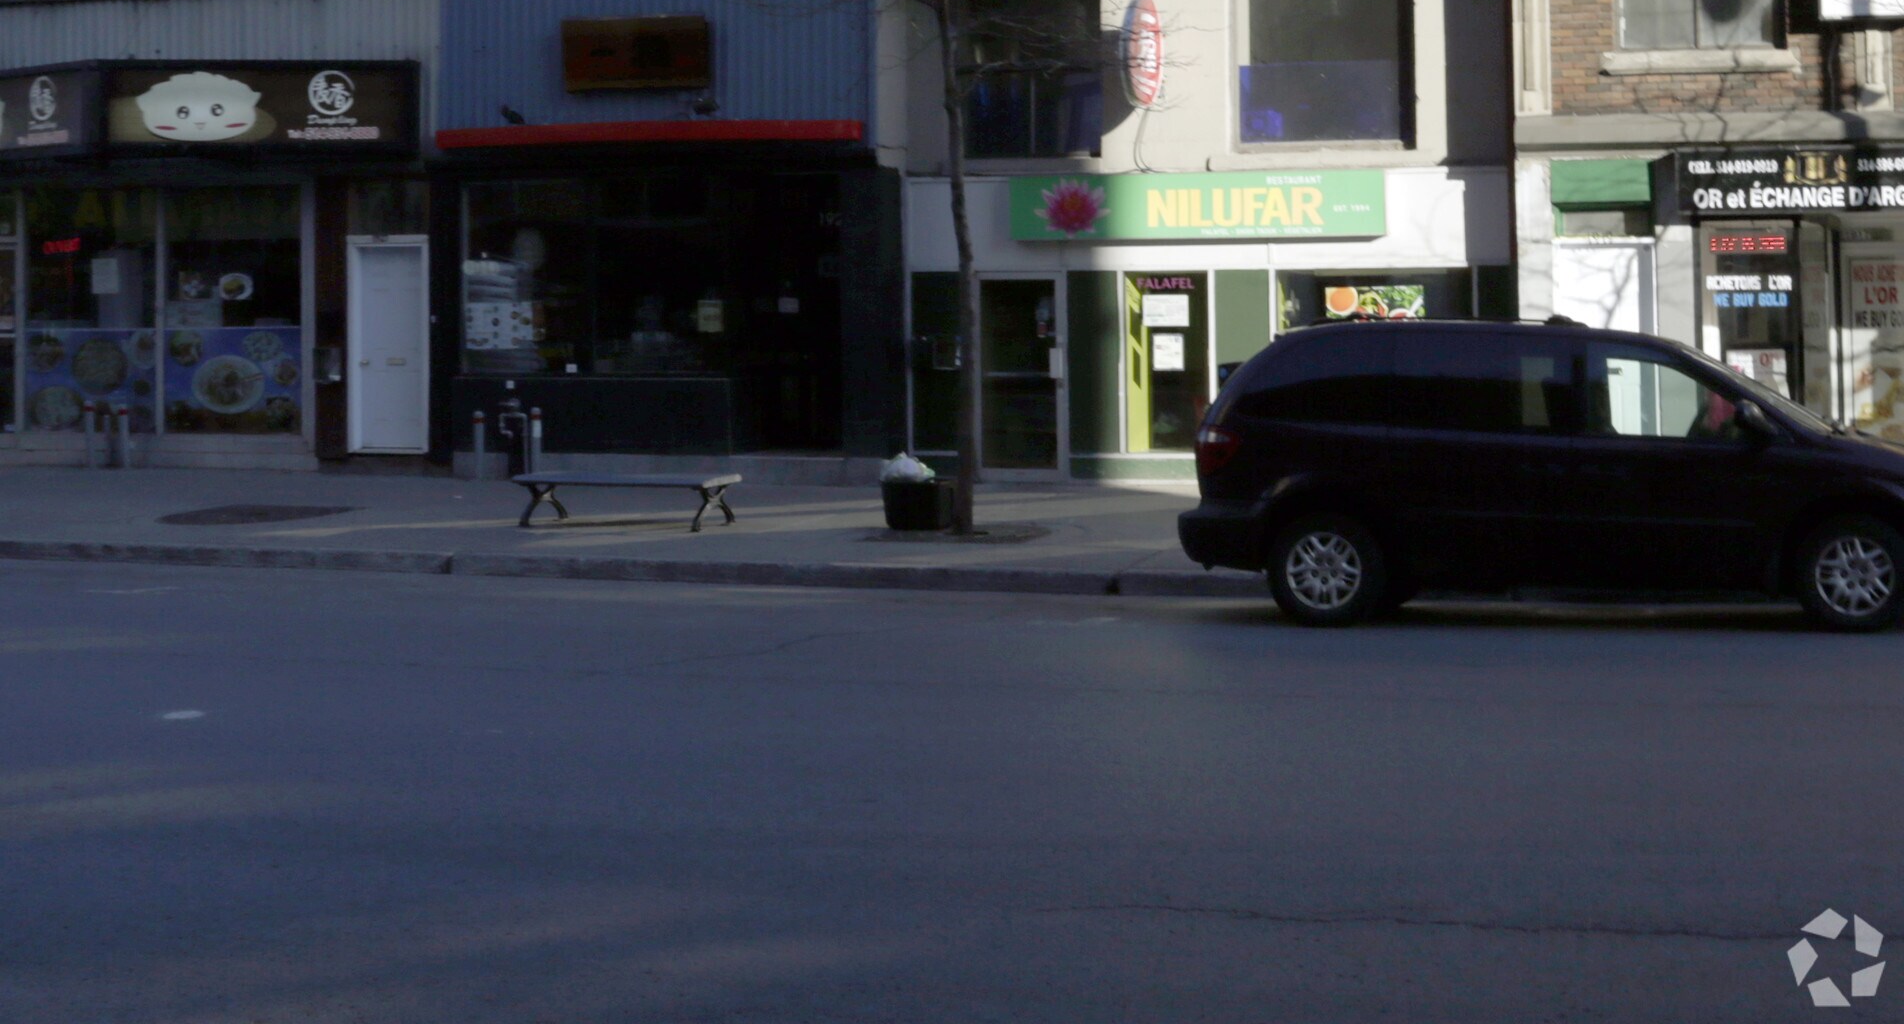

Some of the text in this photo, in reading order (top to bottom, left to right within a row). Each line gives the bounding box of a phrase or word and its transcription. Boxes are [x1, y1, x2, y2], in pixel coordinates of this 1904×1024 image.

[1266, 175, 1322, 185] RESTAURANT
[1693, 188, 1723, 209] OR
[1726, 189, 1746, 209] et
[1750, 180, 1845, 208] ÉCHANGE
[1147, 187, 1324, 228] NILUFAR
[1136, 277, 1195, 289] FALAFEL
[1714, 293, 1788, 307] WE BUY GOLD
[1864, 286, 1898, 305] L'OR
[1870, 310, 1887, 327] BUY
